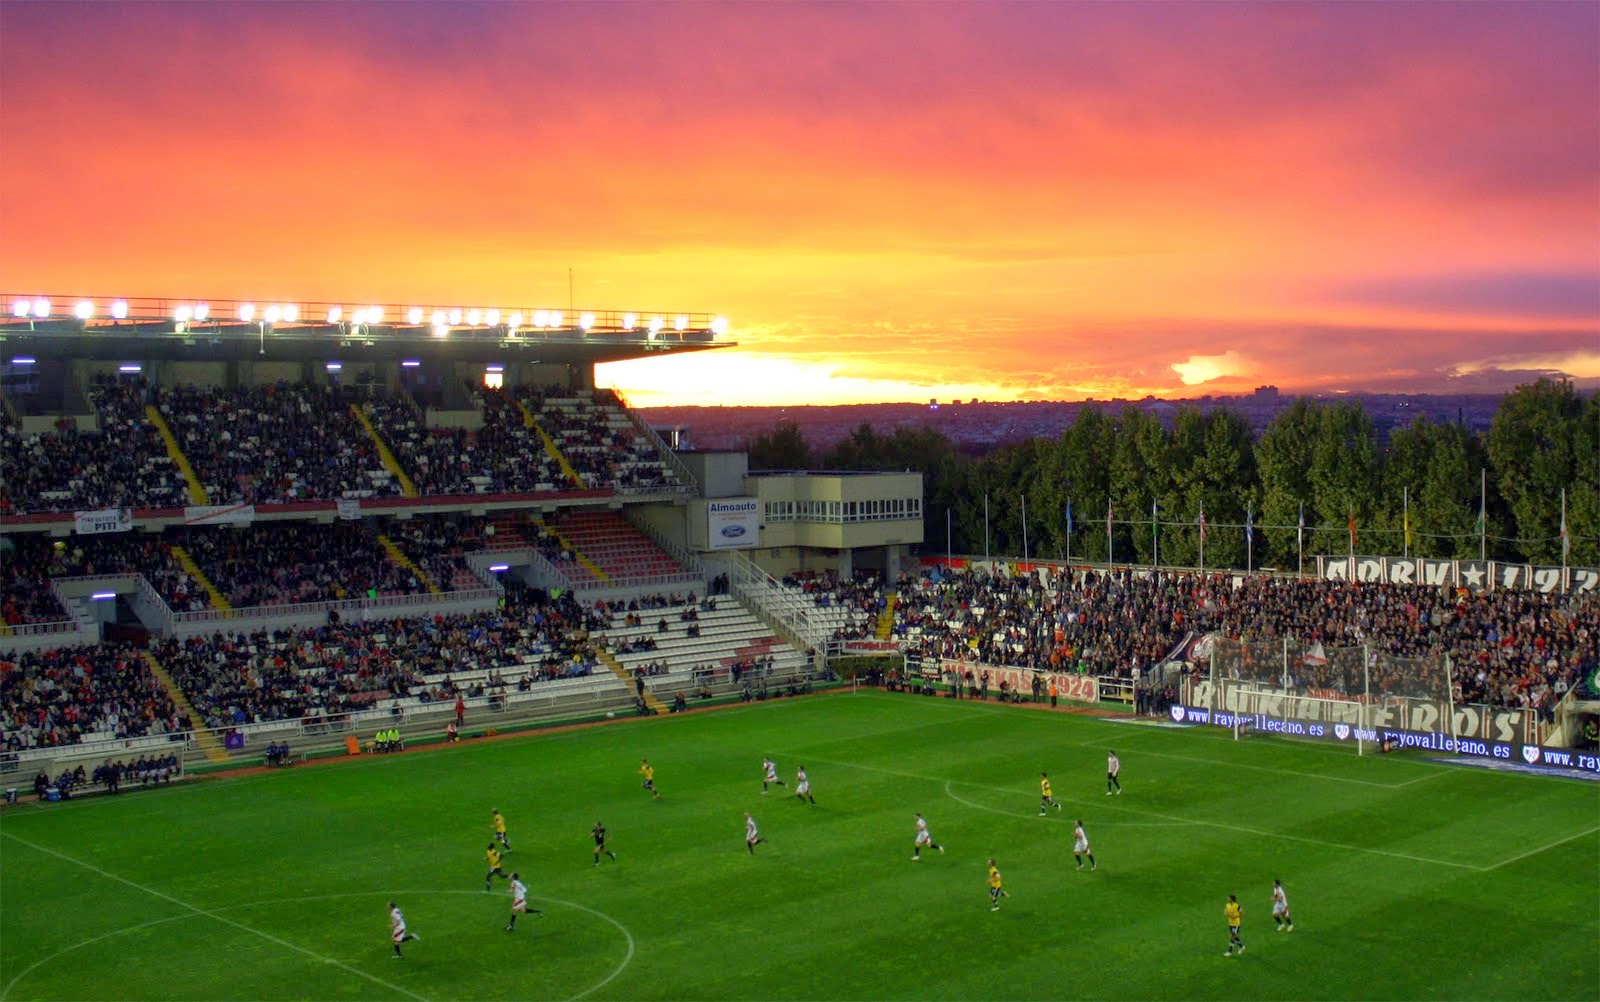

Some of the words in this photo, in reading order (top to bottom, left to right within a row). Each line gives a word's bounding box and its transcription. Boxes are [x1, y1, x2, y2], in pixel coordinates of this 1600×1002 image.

[710, 503, 756, 512] Almoauto
[95, 522, 116, 531] PITI
[1325, 559, 1451, 586] ADRV
[1049, 675, 1095, 698] 1924
